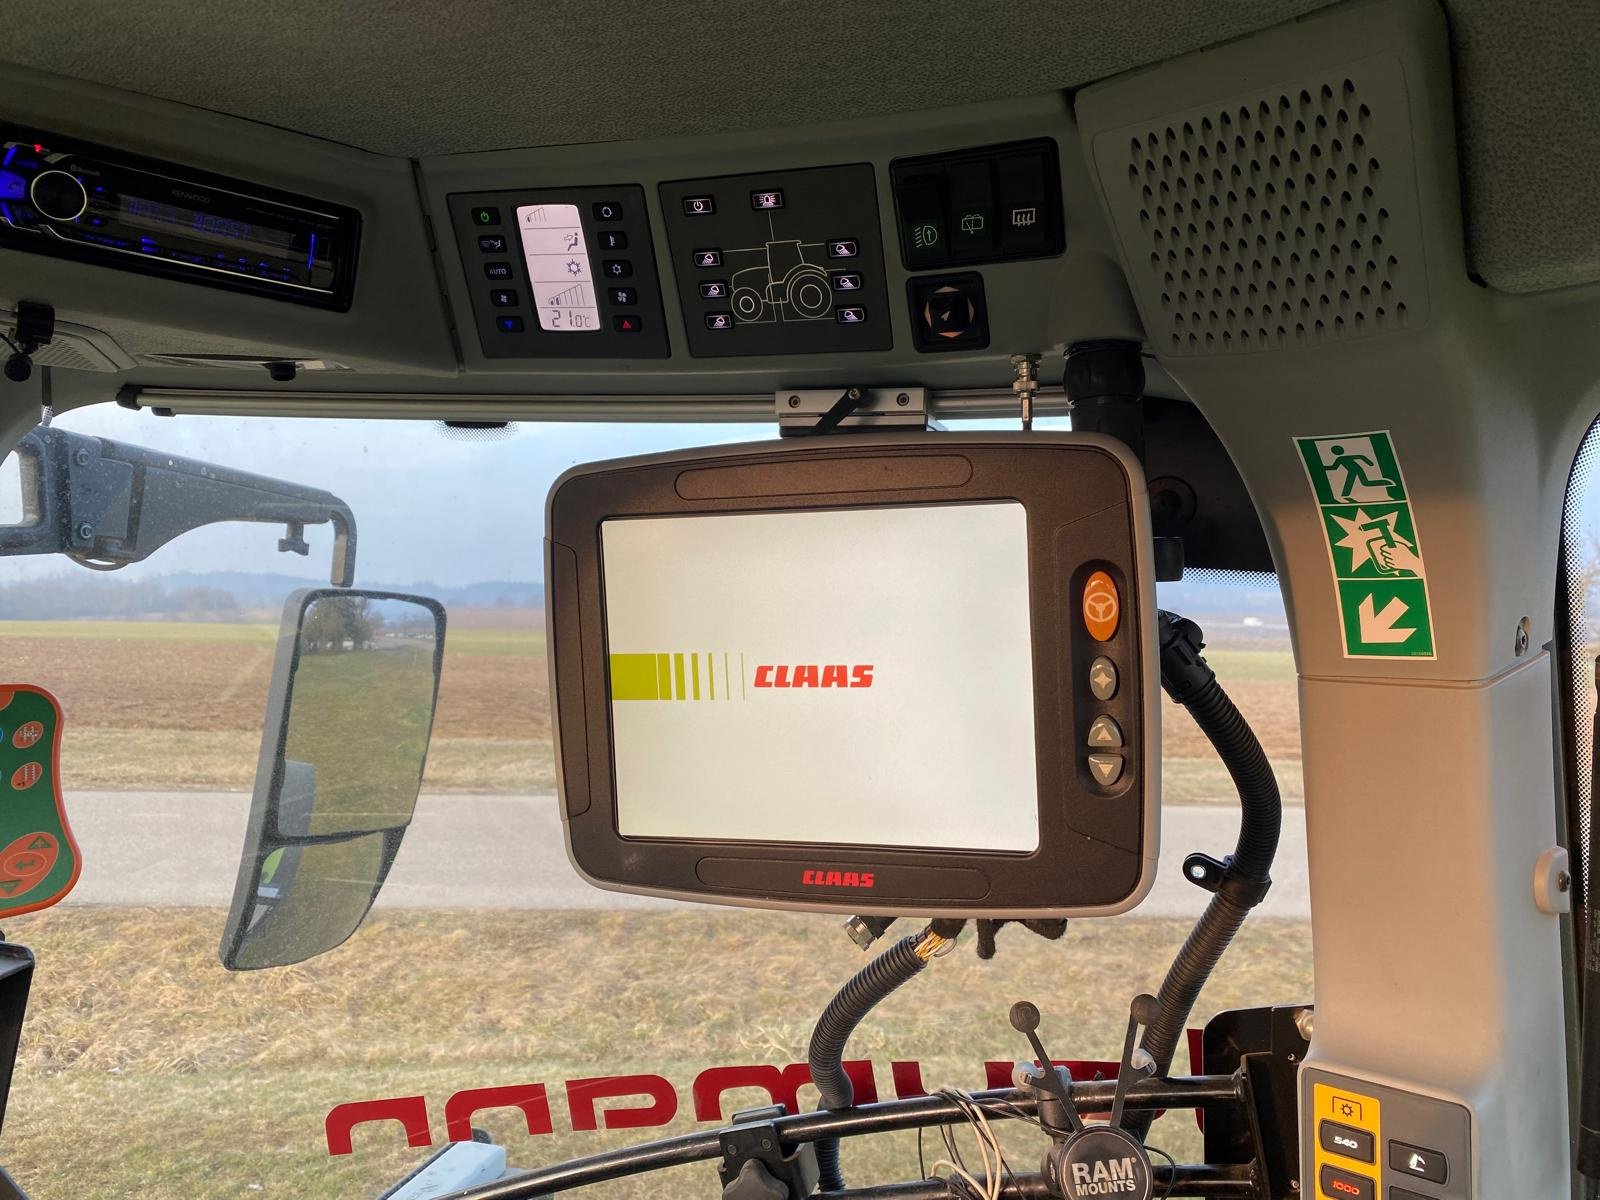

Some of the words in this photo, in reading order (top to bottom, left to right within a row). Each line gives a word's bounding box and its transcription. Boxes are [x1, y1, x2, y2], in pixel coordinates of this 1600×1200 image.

[489, 267, 507, 276] AUTO
[754, 665, 874, 688] CLAAS
[802, 870, 875, 888] CLAAS
[1333, 1135, 1359, 1150] 540
[1075, 1179, 1136, 1197] MOUNTS
[1332, 1180, 1361, 1196] 1000
